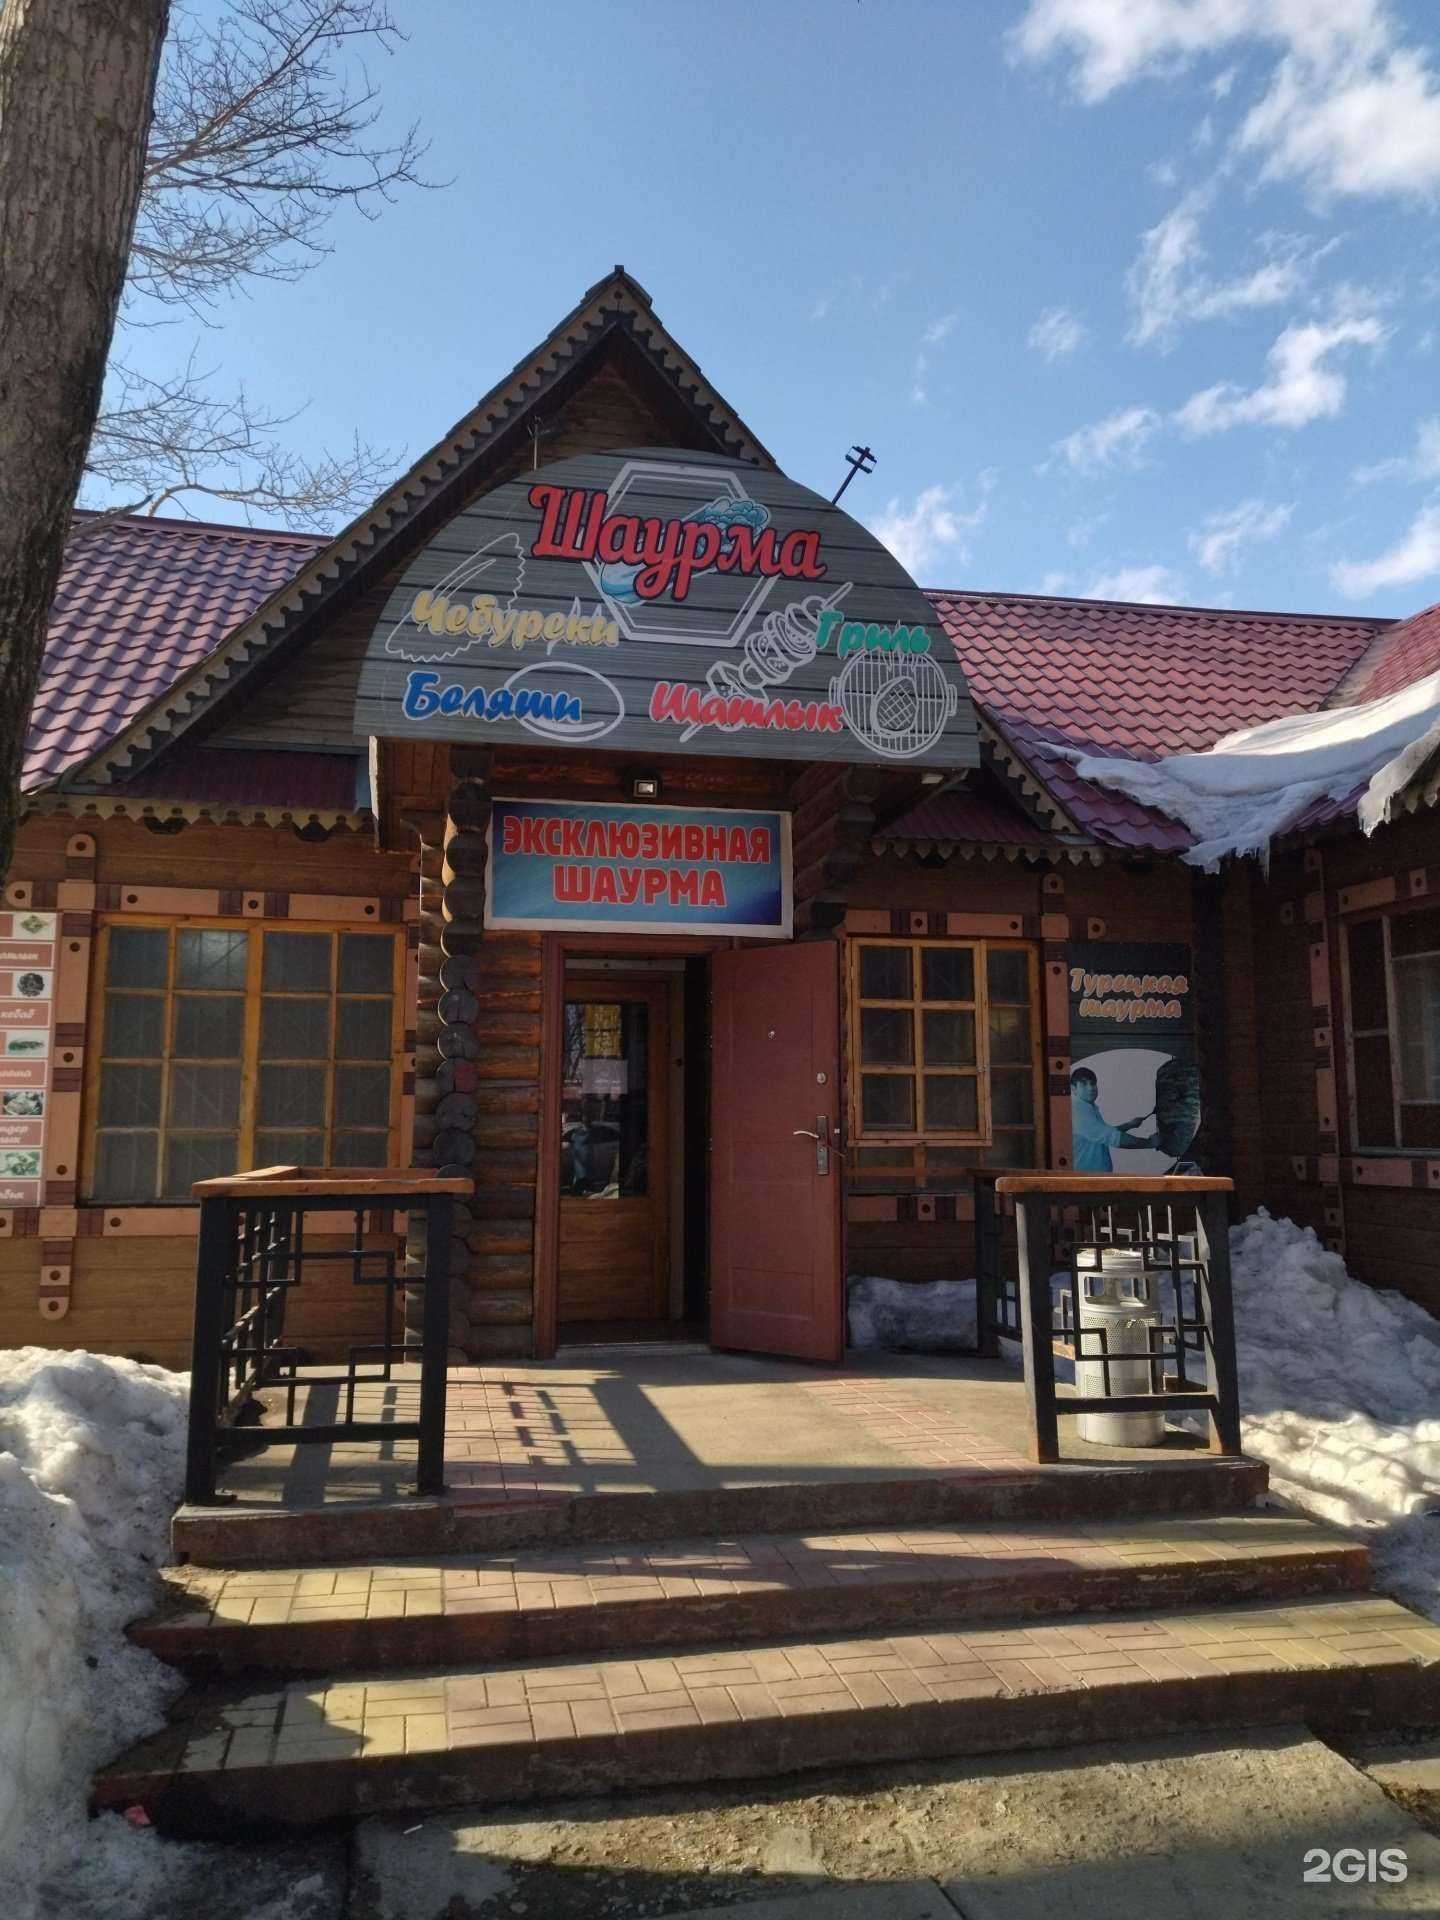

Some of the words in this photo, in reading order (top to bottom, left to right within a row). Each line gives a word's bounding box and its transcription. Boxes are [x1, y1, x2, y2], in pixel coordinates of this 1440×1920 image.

[528, 484, 828, 601] Шаурма
[411, 590, 620, 651] Чебуреки
[814, 609, 932, 660] Гриль
[402, 670, 582, 722] Беляши
[648, 681, 845, 733] Шашлык
[503, 815, 772, 864] ЭКСКЛЮЗИВНАЯ
[553, 864, 728, 908] ШАУРМА
[1069, 967, 1189, 998] Турецкая
[1079, 998, 1182, 1022] шаурма
